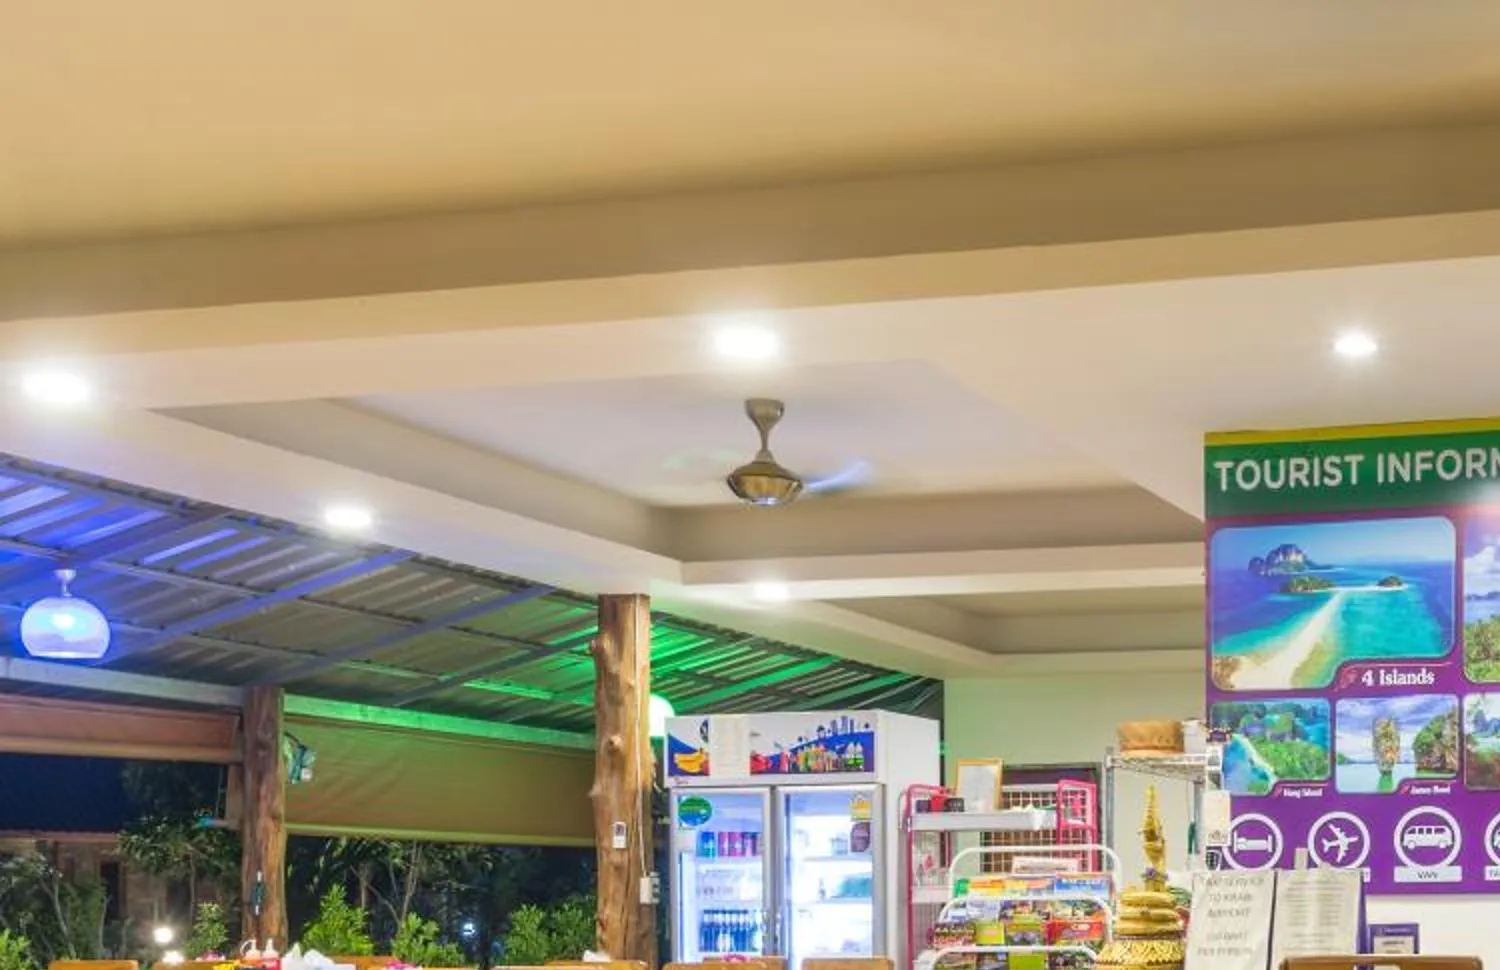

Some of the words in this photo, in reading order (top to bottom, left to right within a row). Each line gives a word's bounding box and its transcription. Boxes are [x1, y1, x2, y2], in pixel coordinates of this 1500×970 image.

[1214, 455, 1365, 491] TOURIST
[1361, 669, 1375, 687] 4
[1379, 668, 1434, 687] Islands
[1416, 871, 1439, 880] VAN
